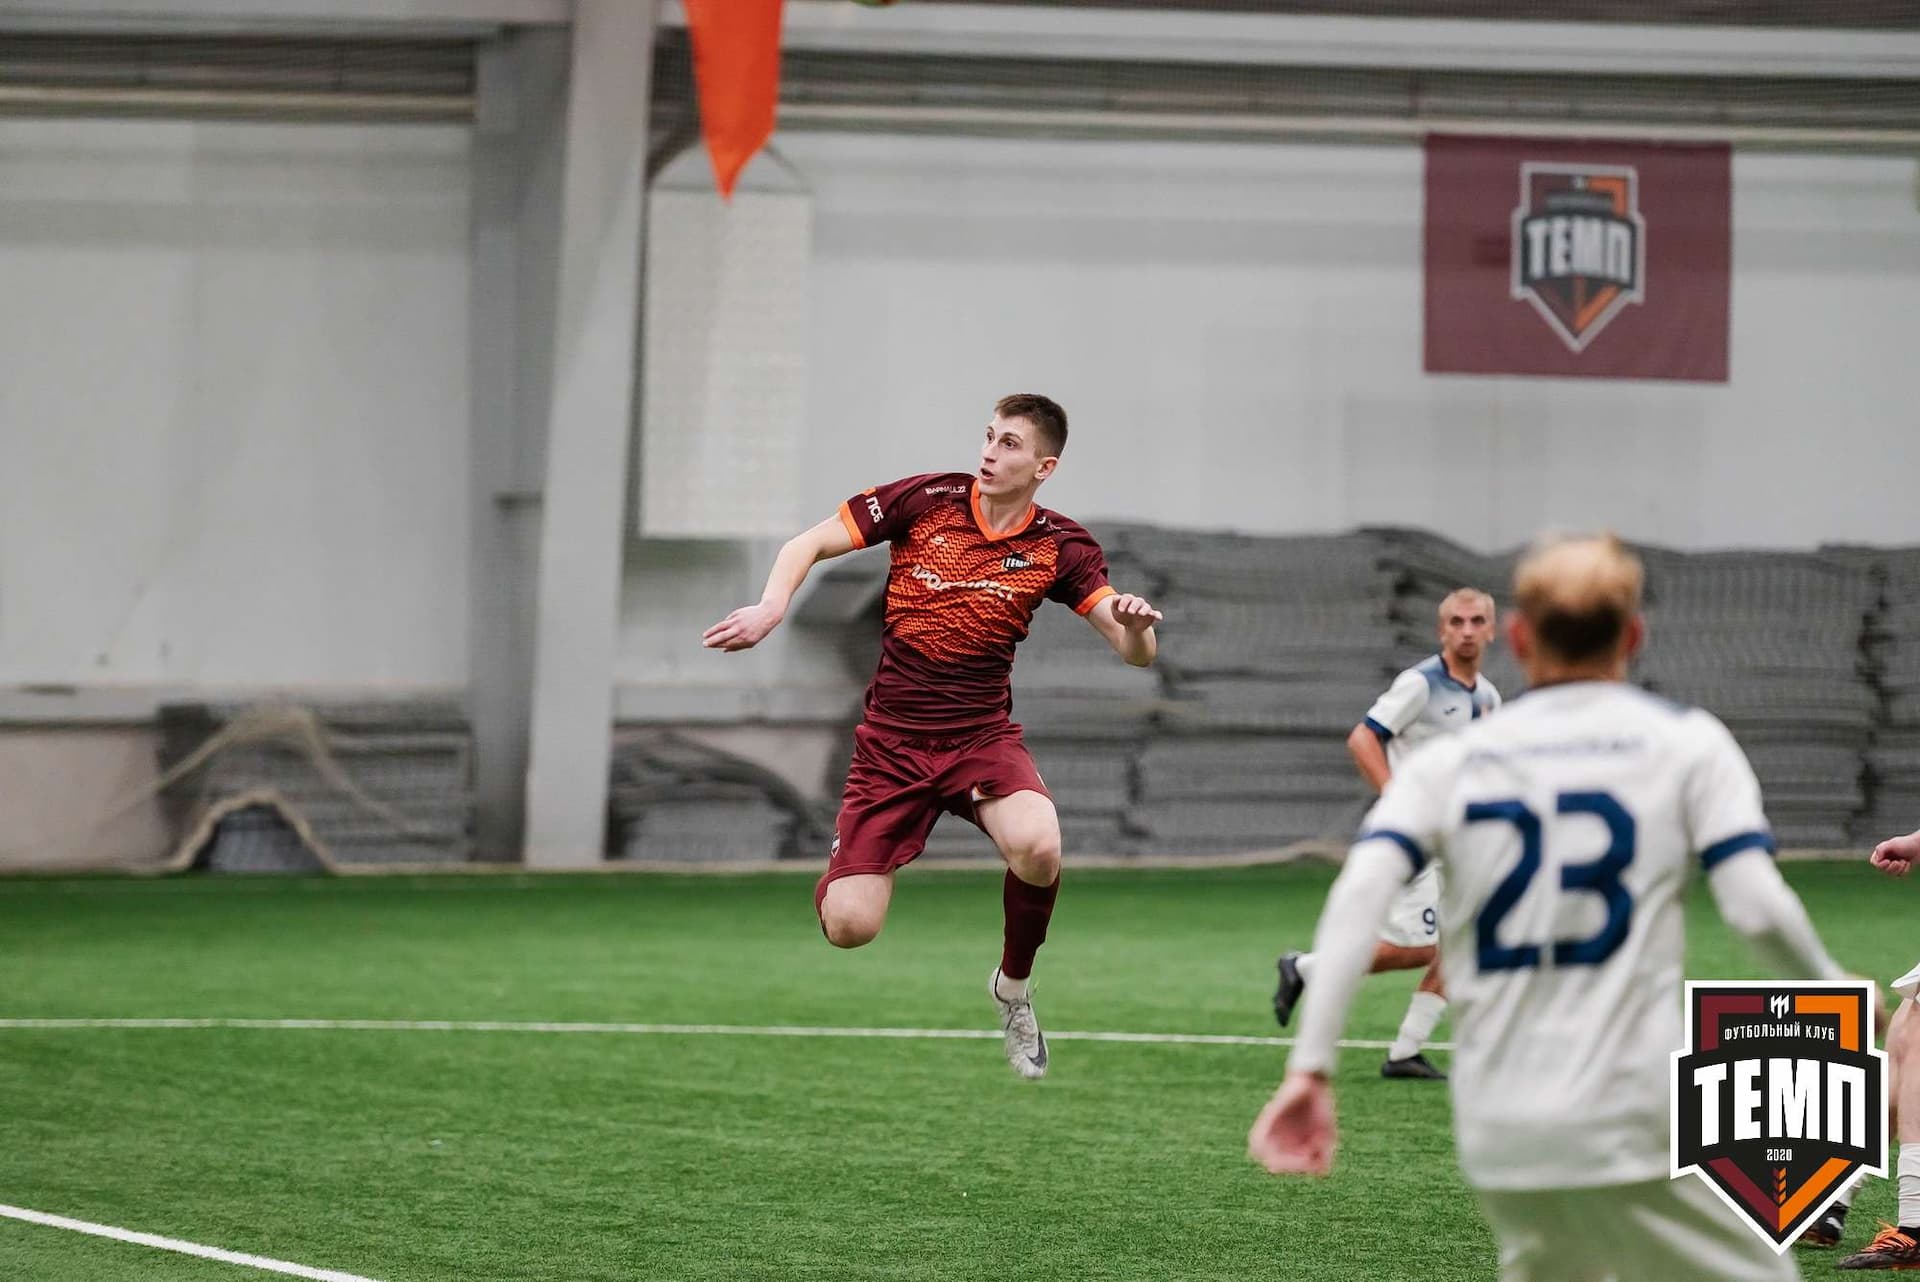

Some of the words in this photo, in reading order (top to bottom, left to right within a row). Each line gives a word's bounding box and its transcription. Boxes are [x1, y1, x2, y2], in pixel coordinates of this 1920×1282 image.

[1526, 215, 1631, 283] ТЕМП
[865, 496, 884, 523] ПСБ
[1464, 791, 1637, 972] 23
[1422, 907, 1437, 935] 9
